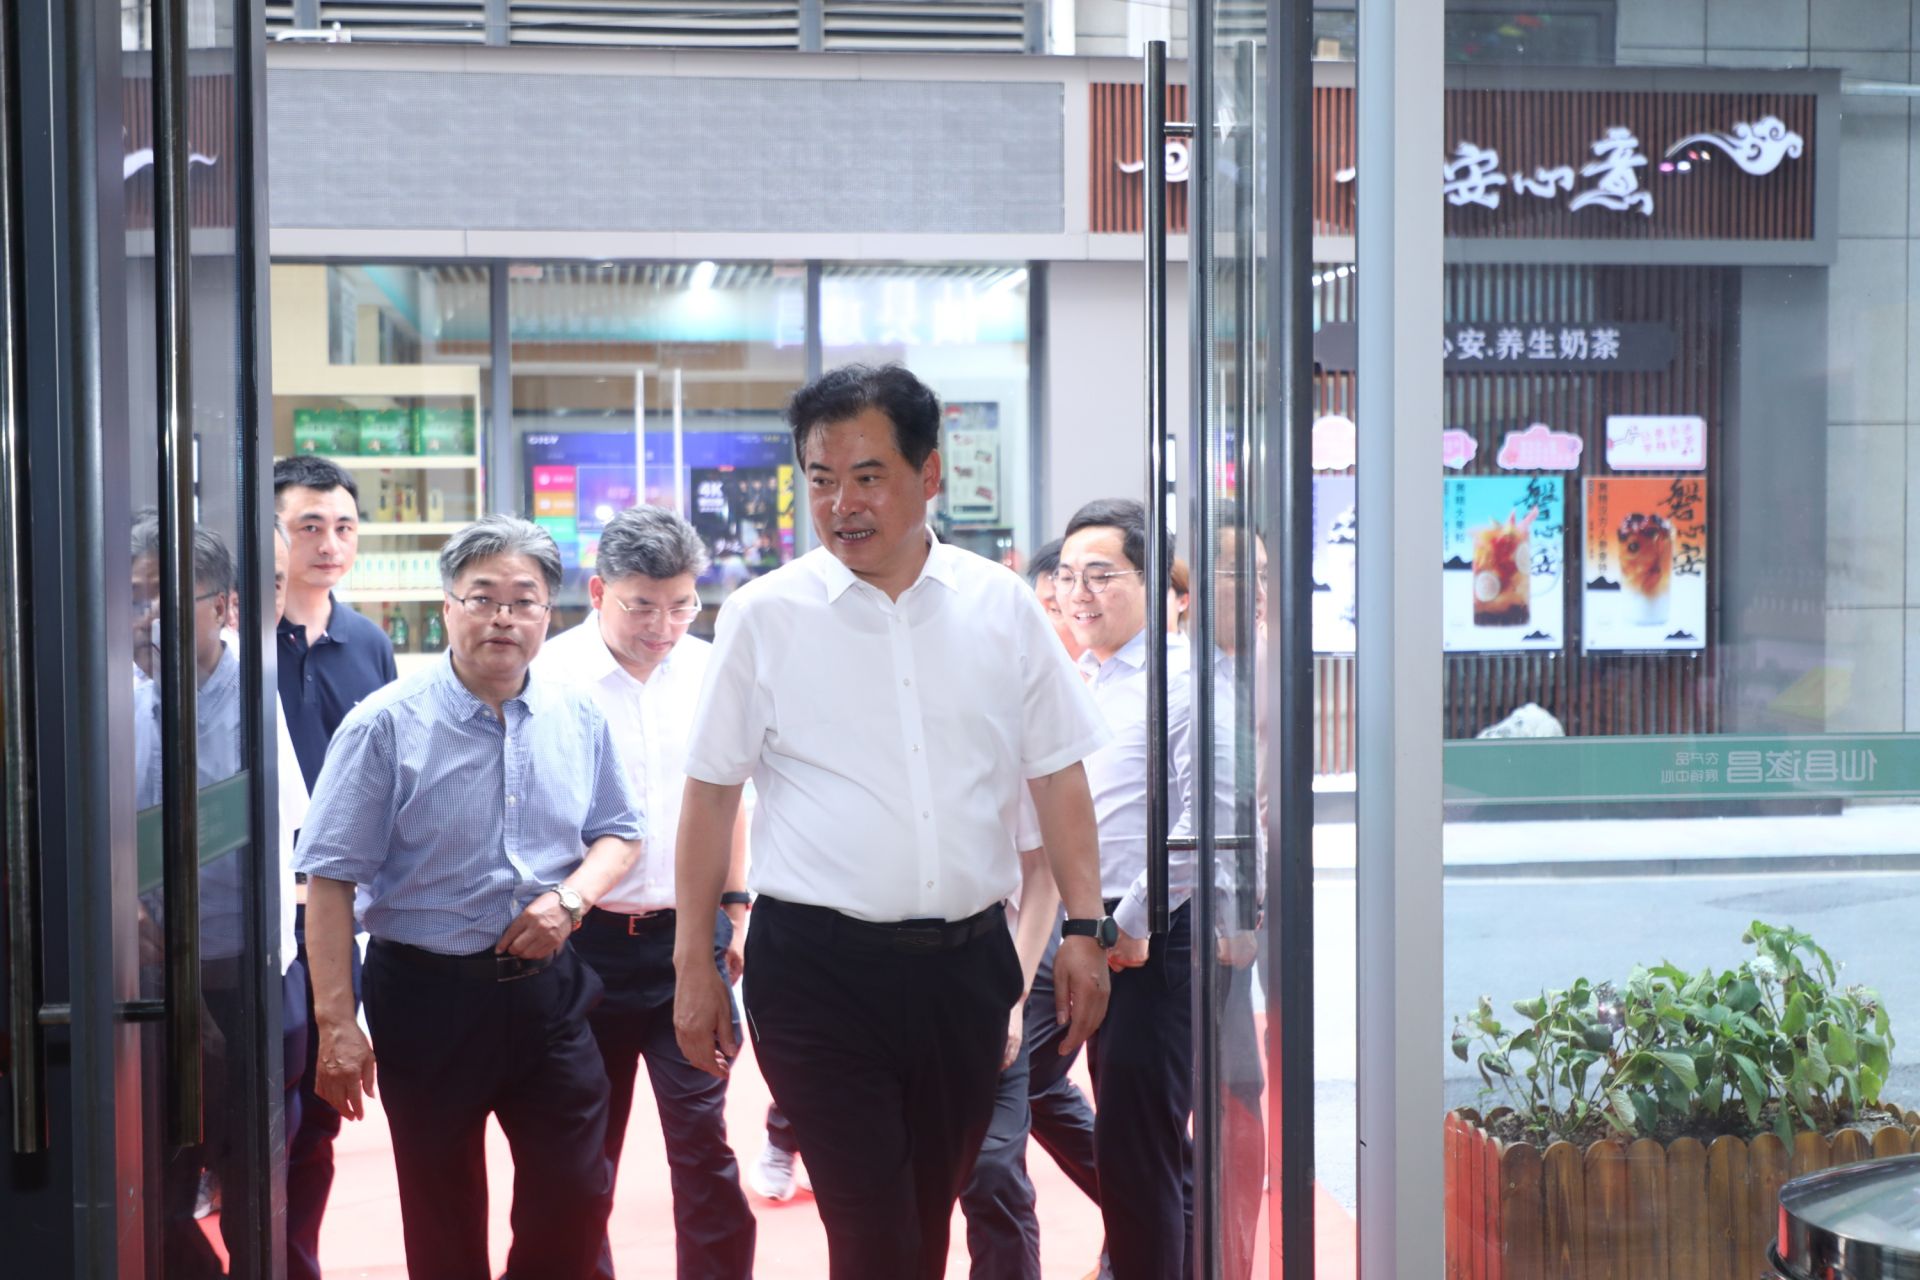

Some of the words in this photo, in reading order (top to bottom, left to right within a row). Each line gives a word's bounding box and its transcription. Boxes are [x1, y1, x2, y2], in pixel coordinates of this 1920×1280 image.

[1335, 127, 1654, 216] 安心意
[1443, 327, 1621, 360] 安.养生奶茶
[697, 480, 724, 499] 4K
